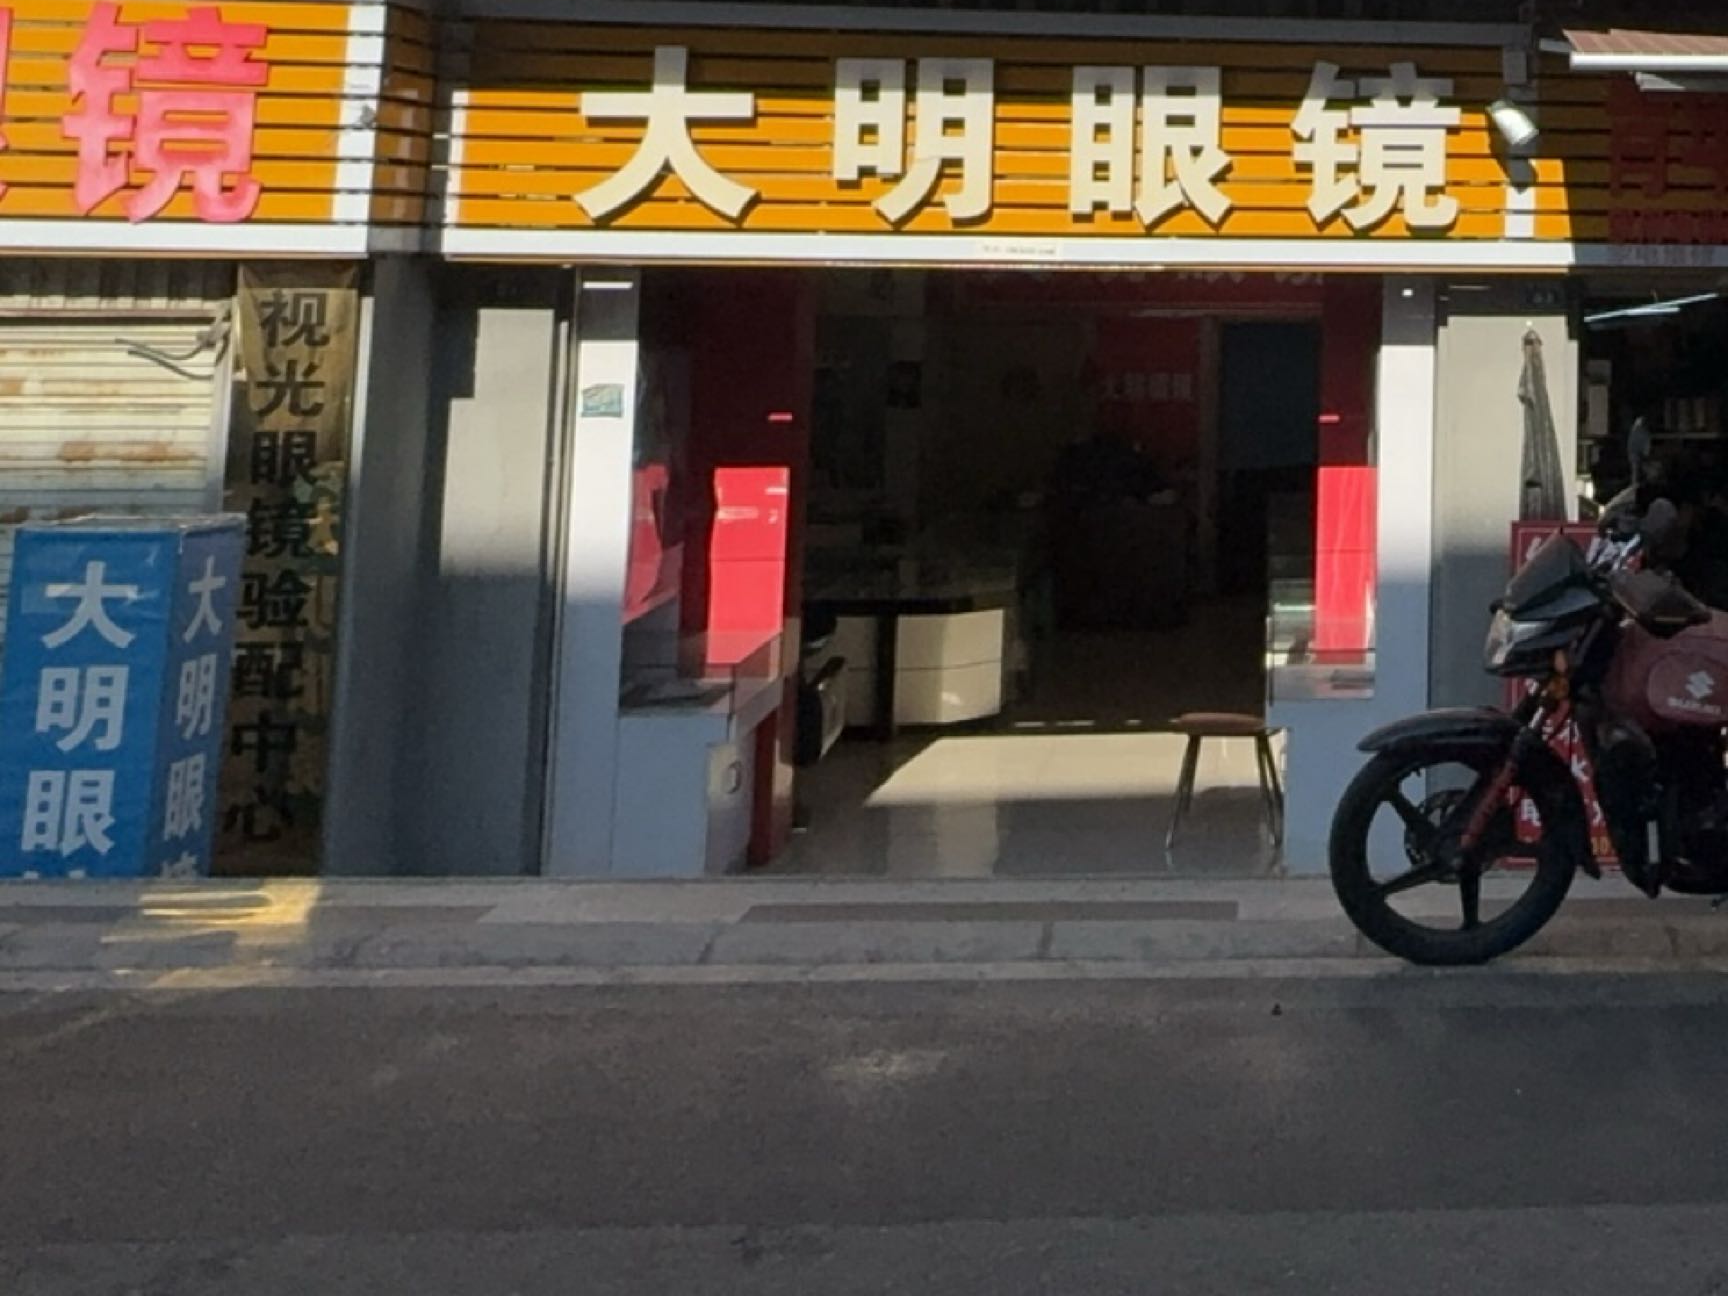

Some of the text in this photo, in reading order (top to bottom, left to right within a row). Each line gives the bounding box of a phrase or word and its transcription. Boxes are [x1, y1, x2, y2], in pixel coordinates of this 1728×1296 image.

[0, 1, 269, 224] 镜
[574, 44, 1461, 232] 大明眼镜
[224, 290, 330, 844] 视光眼镜验配中心
[20, 560, 139, 877] 大明眼
